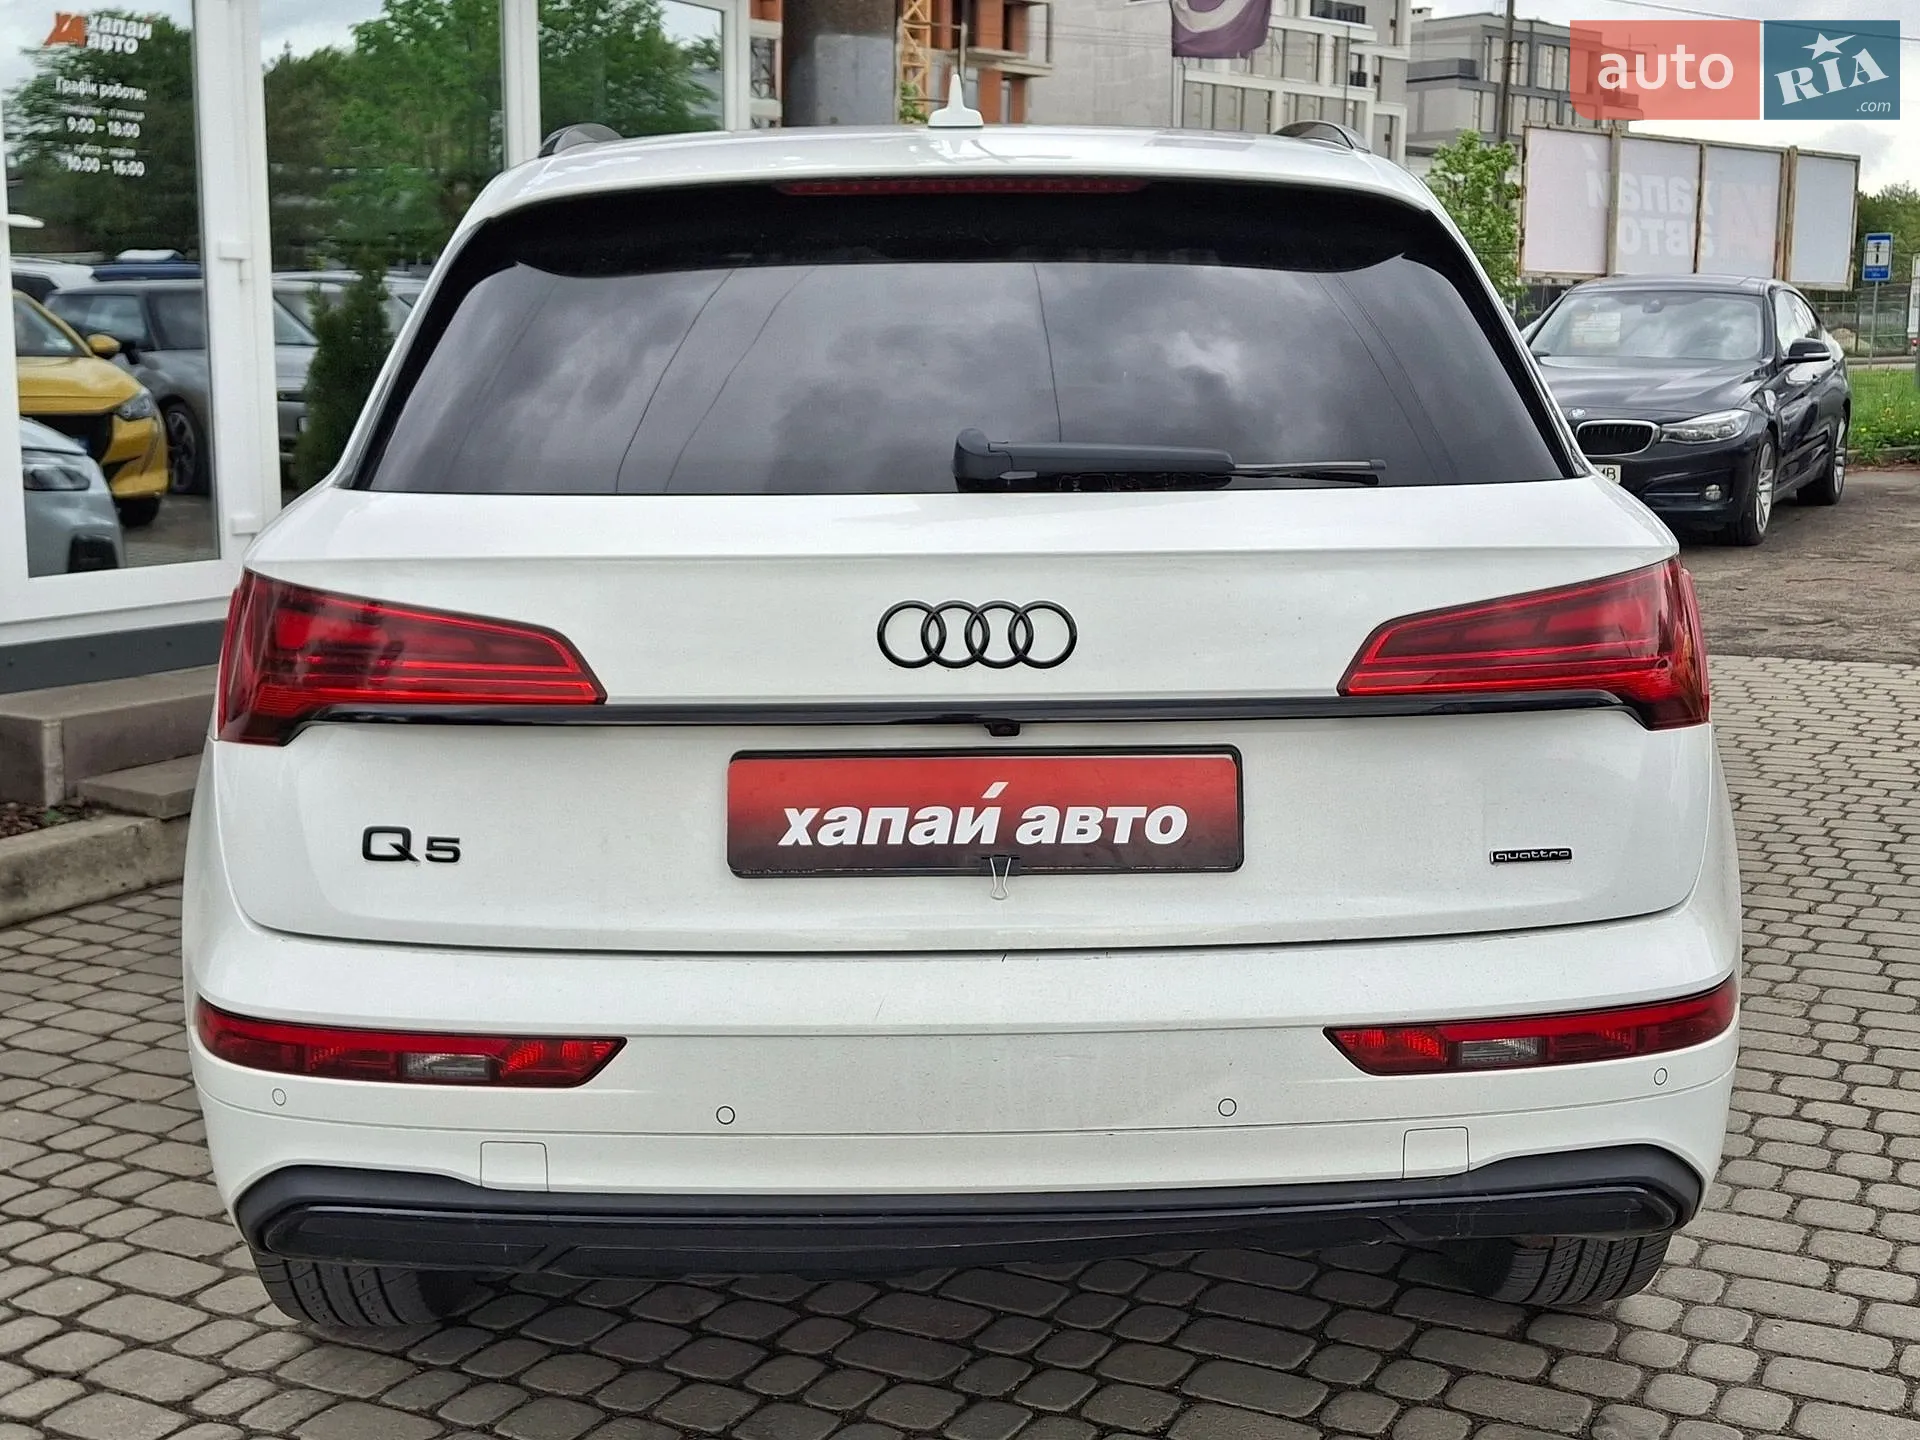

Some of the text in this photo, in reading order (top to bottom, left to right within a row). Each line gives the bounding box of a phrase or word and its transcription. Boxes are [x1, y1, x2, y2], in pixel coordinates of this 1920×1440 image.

[87, 32, 139, 54] авто
[66, 116, 96, 134] 9:00
[777, 781, 1188, 846] хапай авто
[362, 825, 461, 863] Q5
[1495, 849, 1570, 862] quattro
